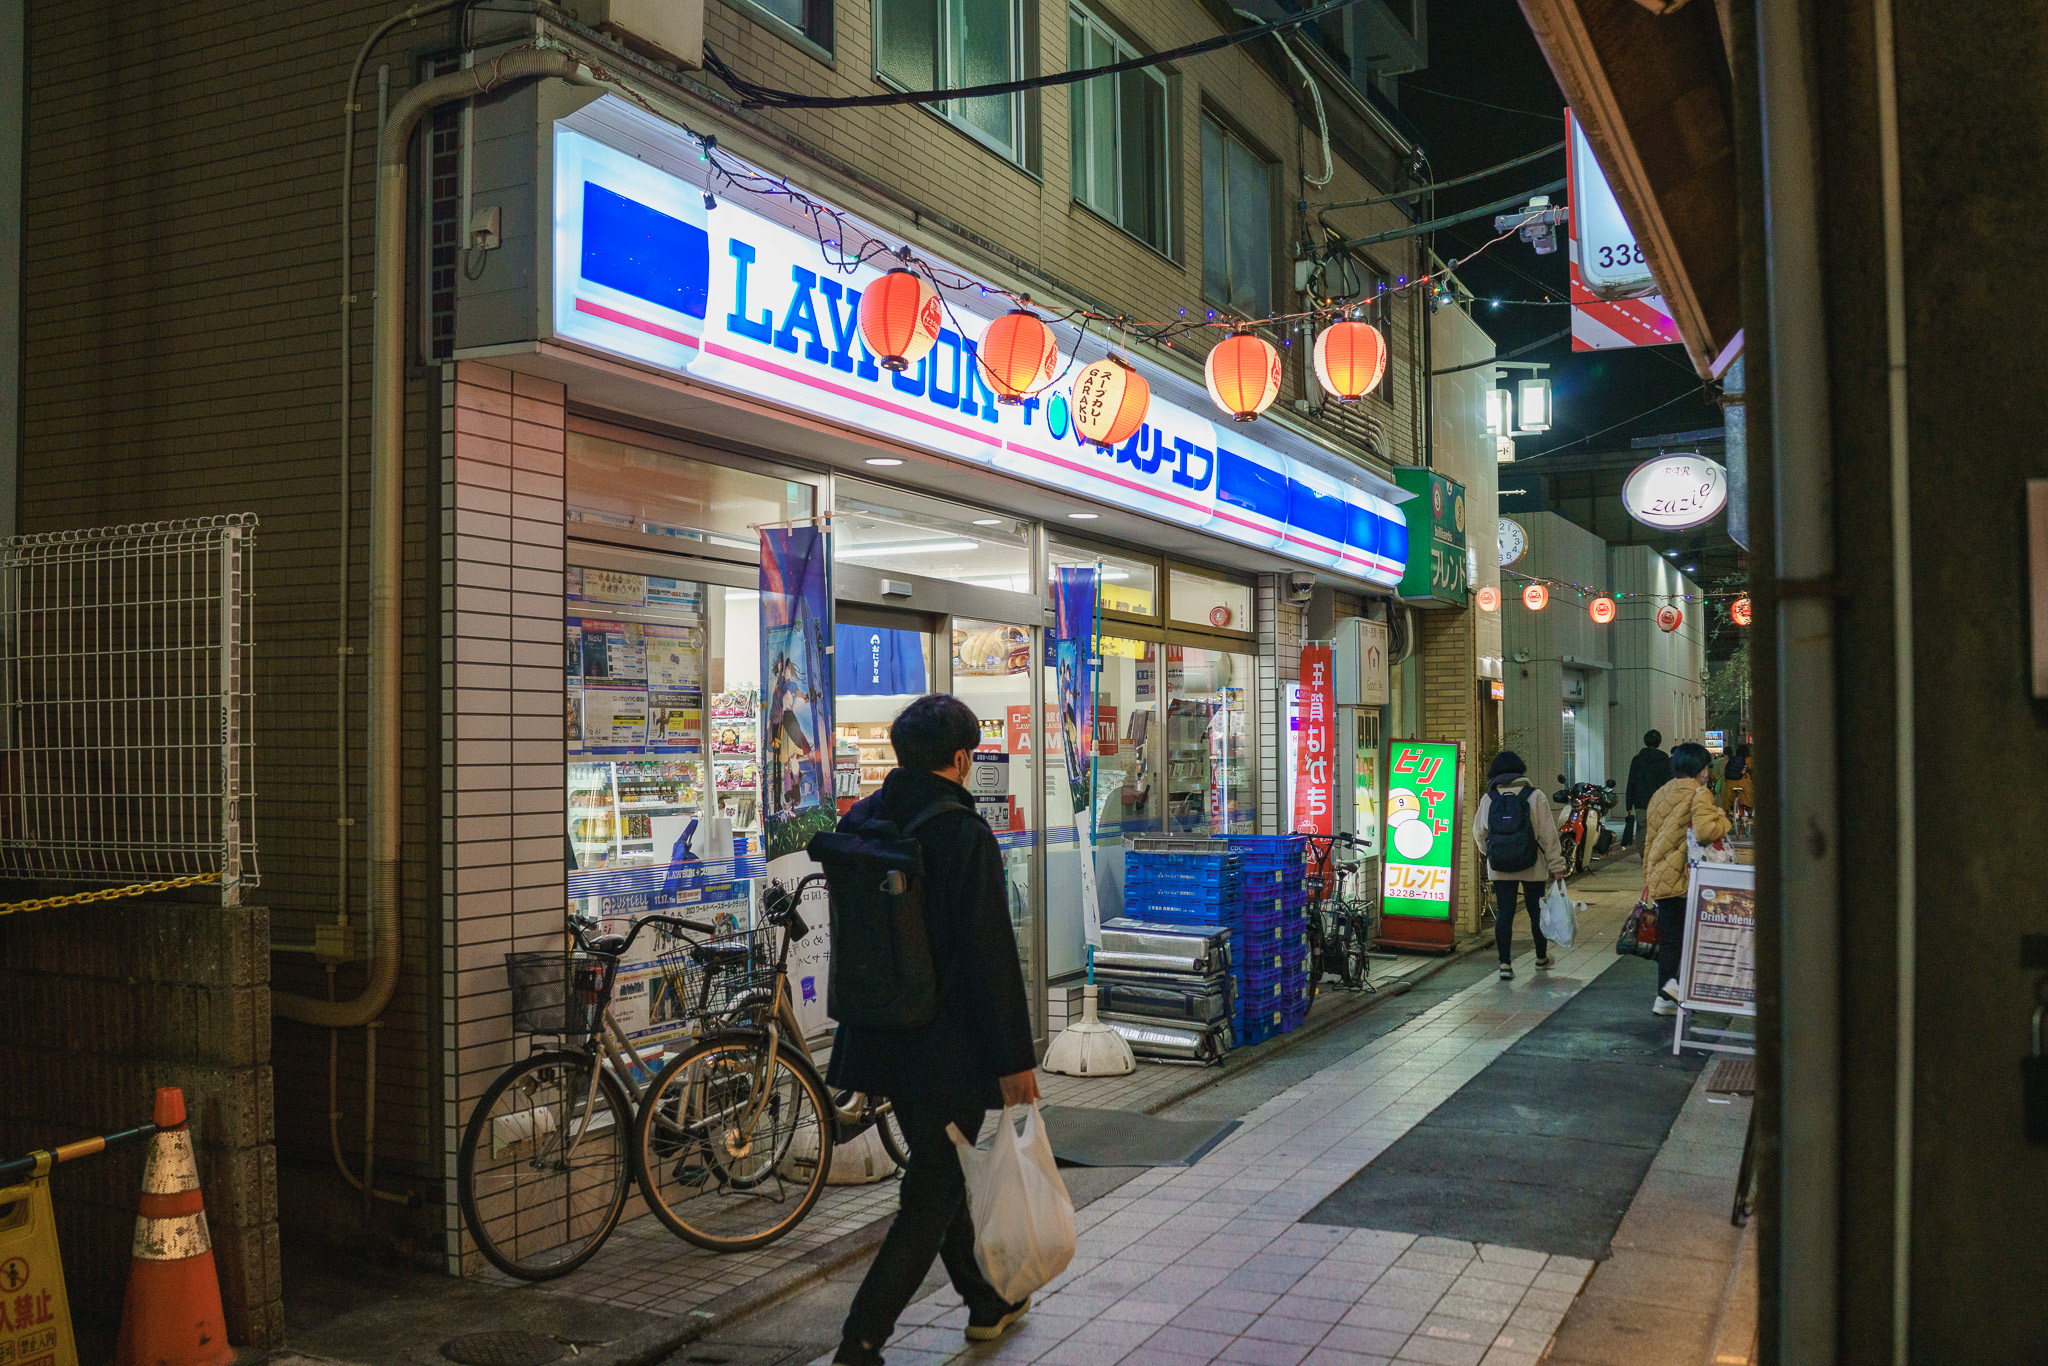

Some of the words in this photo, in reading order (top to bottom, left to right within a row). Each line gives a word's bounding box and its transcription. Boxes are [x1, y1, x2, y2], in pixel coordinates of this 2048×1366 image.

[1078, 368, 1101, 424] GARAKU
[1090, 371, 1112, 427] スープカレー
[1663, 466, 1691, 477] BAR
[1652, 481, 1713, 513] zazie
[1431, 548, 1466, 594] フレンド
[1017, 731, 1062, 750] AM
[1398, 798, 1405, 807] 9
[1388, 866, 1447, 890] フレンド
[1389, 888, 1445, 901] 3228-7113
[1700, 911, 1726, 923] Drink
[1728, 914, 1755, 926] Menu
